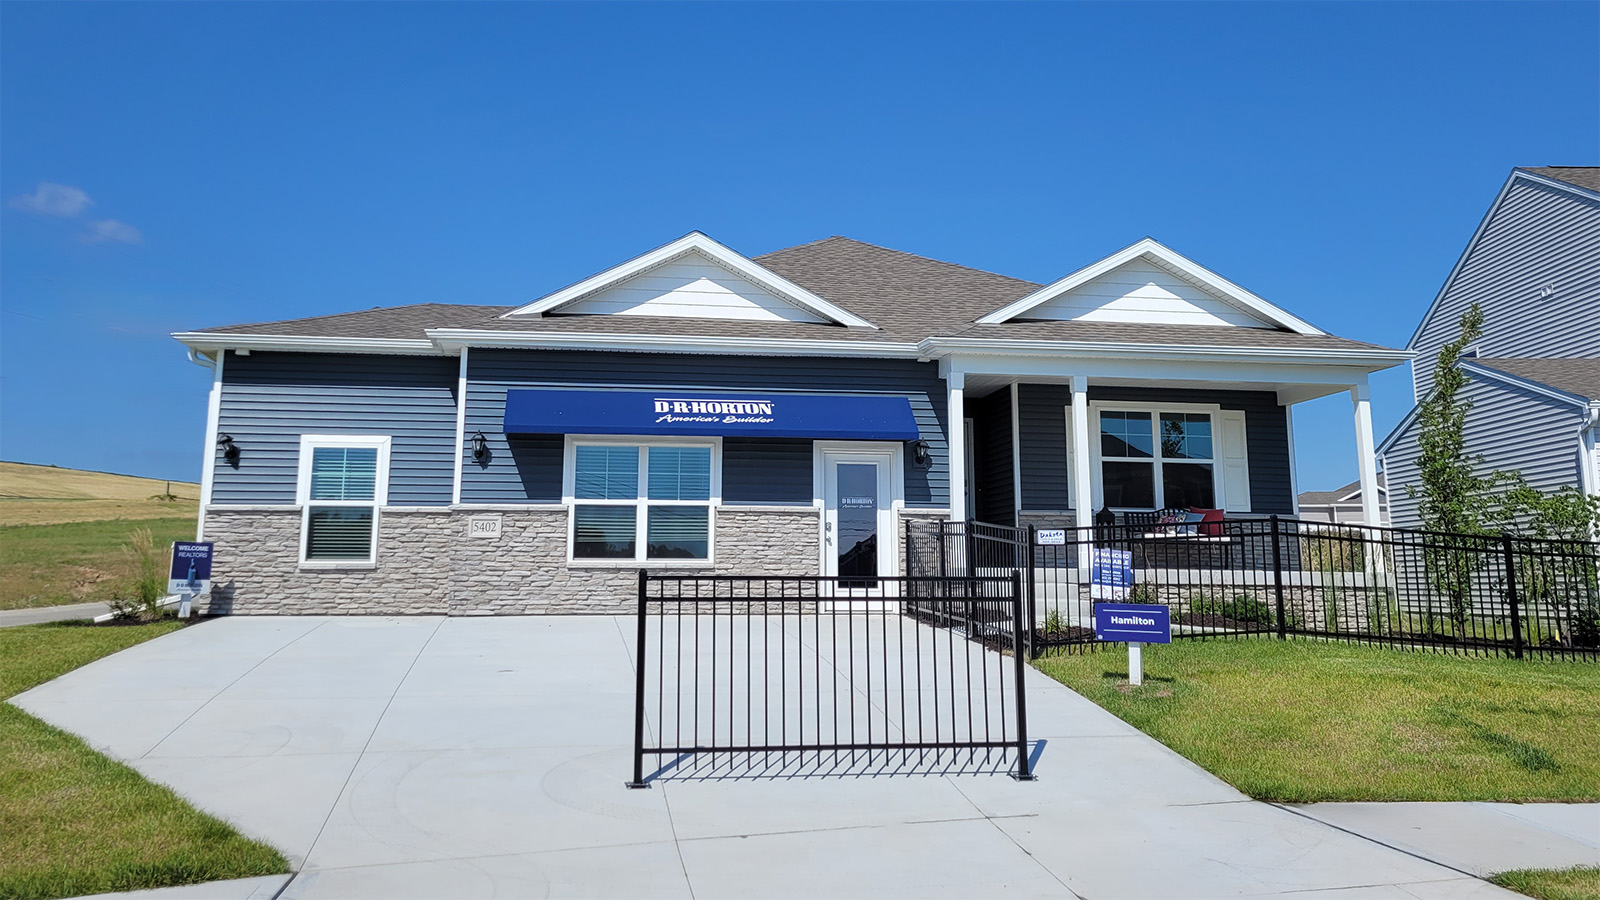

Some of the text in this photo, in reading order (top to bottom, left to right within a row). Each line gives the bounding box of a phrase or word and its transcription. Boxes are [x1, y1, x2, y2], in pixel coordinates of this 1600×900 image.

[655, 413, 774, 424] America's Builder
[473, 521, 497, 532] 5402
[1110, 616, 1155, 626] Hamilton
